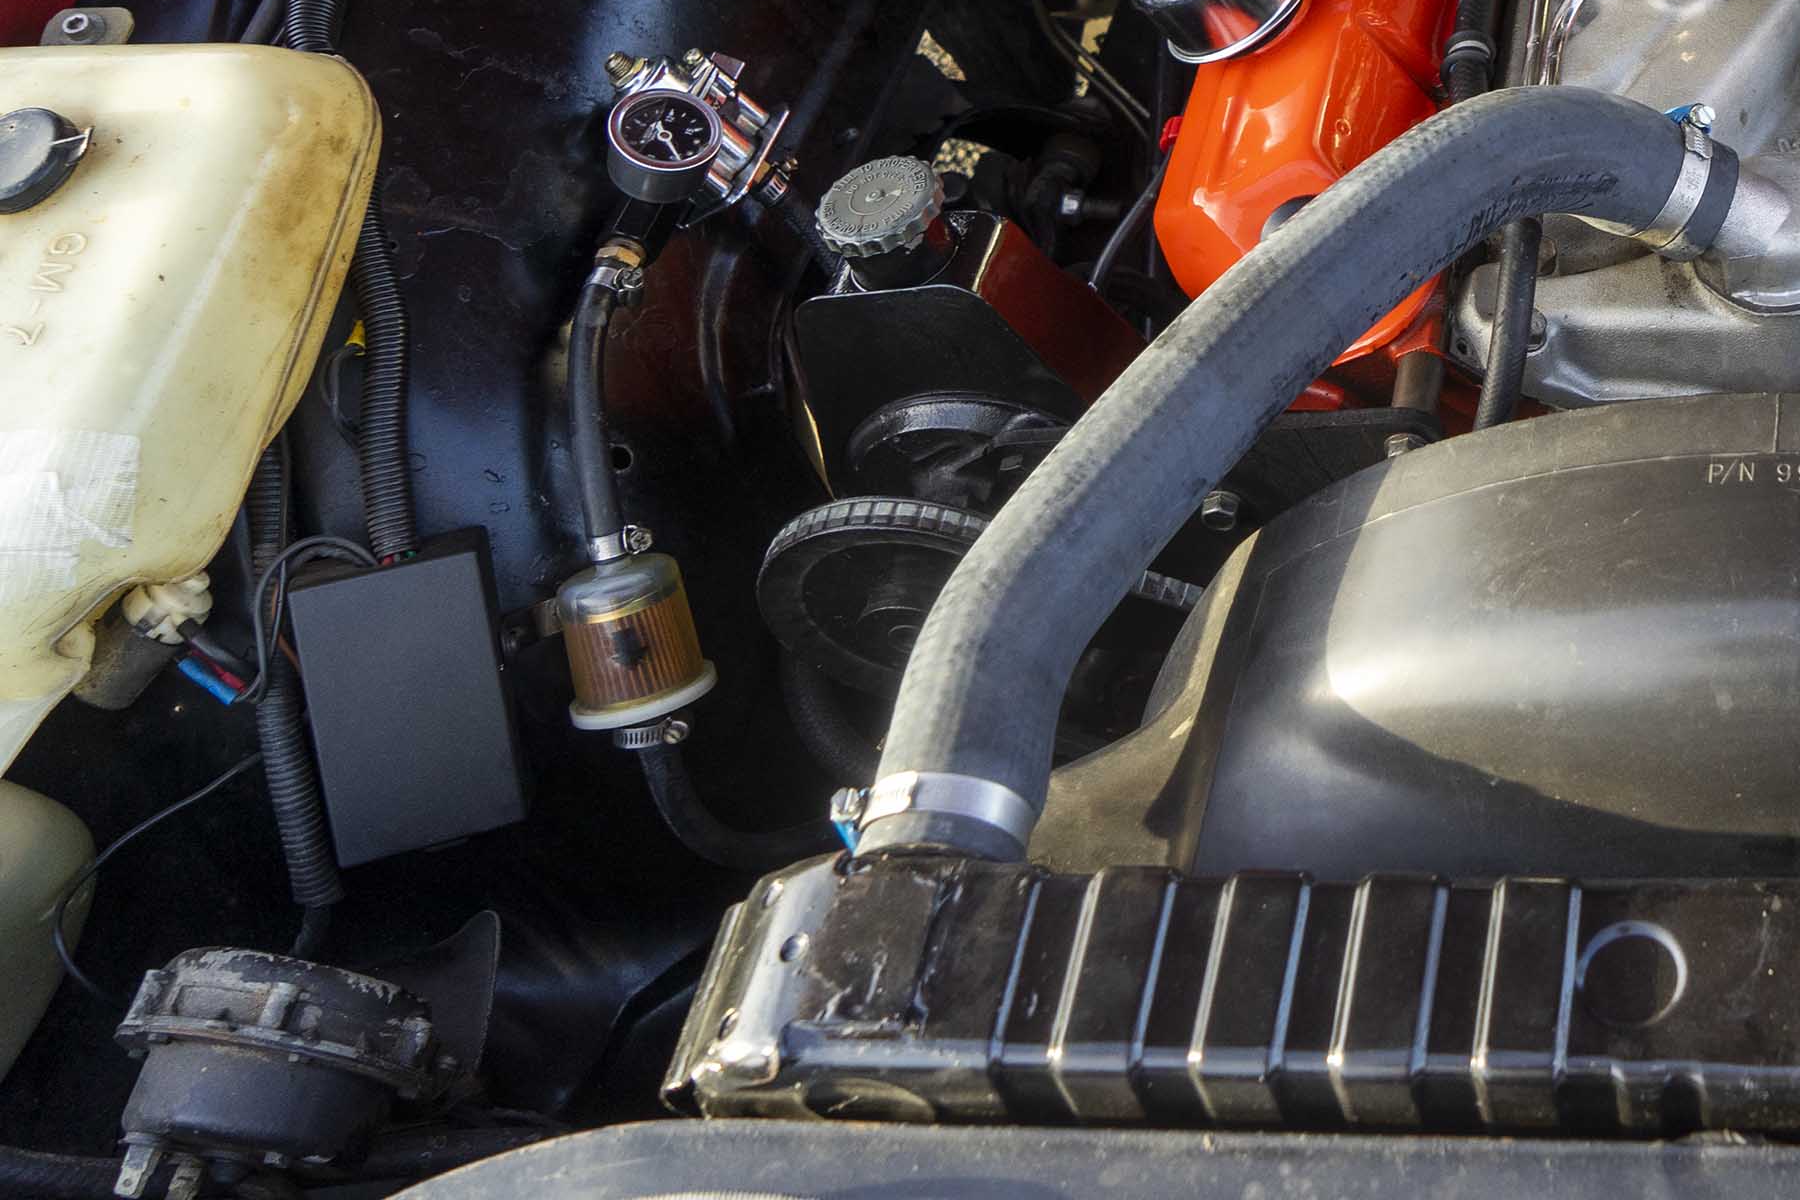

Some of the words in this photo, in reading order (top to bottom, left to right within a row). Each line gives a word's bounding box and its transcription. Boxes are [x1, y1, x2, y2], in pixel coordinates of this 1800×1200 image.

[832, 174, 857, 191] FILL
[860, 163, 873, 175] TO
[824, 200, 835, 218] USE
[882, 202, 912, 224] FLUID
[829, 216, 878, 233] APPROVED
[1707, 458, 1755, 485] P/N
